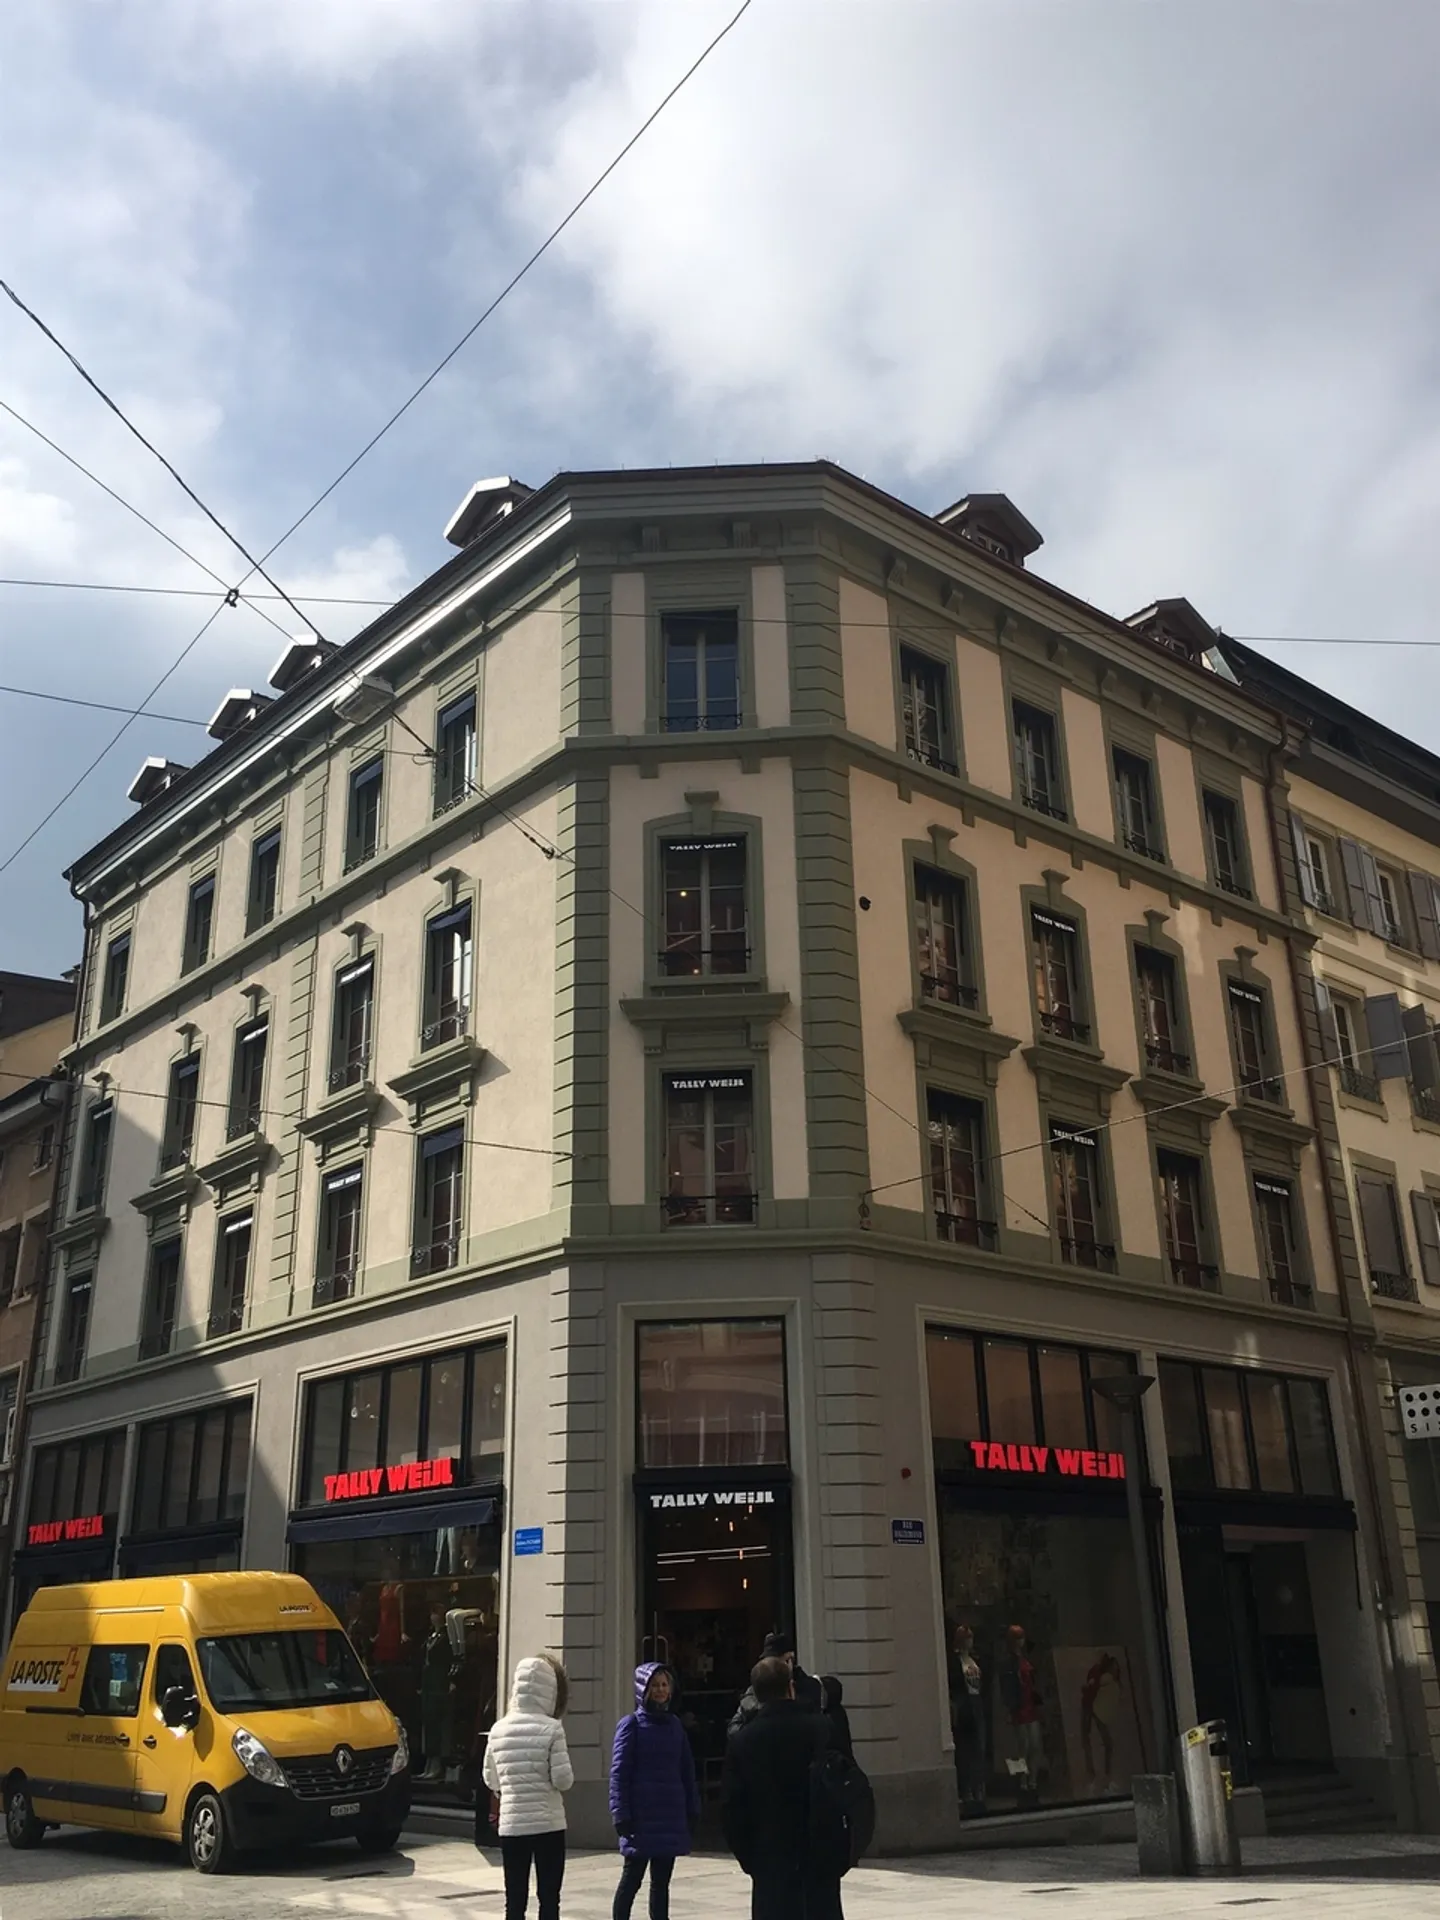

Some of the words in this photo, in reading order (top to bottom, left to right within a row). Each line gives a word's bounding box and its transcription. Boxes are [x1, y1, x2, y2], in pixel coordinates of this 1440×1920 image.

[672, 1079, 706, 1089] TALLY
[1410, 1421, 1440, 1434] SI
[970, 1441, 1048, 1473] TALLY
[324, 1468, 383, 1502] TALLY
[650, 1493, 709, 1508] TALLY
[29, 1521, 63, 1545] TALLY
[10, 1660, 24, 1684] LA
[25, 1660, 66, 1685] POSTE
